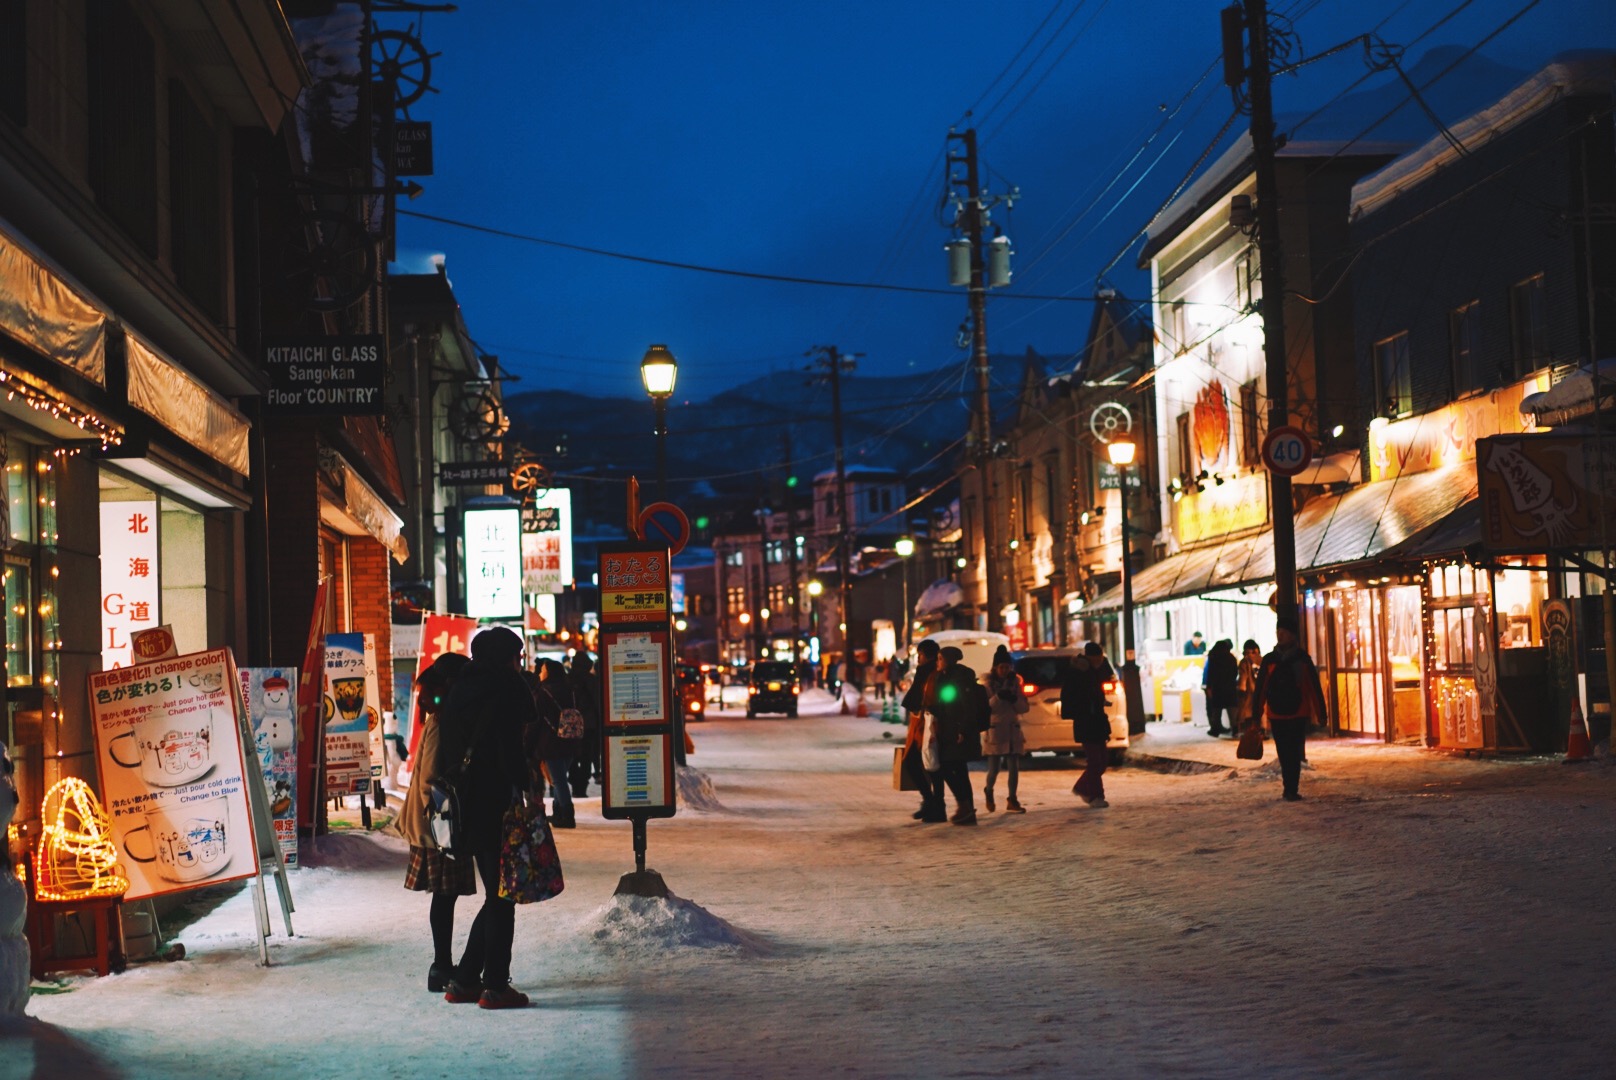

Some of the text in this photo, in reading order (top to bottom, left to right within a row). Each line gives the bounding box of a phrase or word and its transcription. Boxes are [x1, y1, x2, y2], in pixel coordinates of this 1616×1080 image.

[267, 346, 378, 363] KITAICHI GLASS
[289, 366, 355, 384] Sangokan
[268, 389, 303, 405] Floor
[1272, 440, 1305, 463] 40
[522, 509, 534, 520] INE
[606, 557, 661, 573] おたる
[526, 573, 559, 583] ALIAN
[606, 573, 662, 588] 散策バス
[614, 592, 665, 606] 北一硝子前
[621, 614, 648, 622] 中央バス
[154, 657, 192, 675] change
[195, 651, 225, 668] color!
[162, 699, 177, 709] Just
[178, 697, 194, 708] pour
[196, 693, 208, 702] hot
[168, 699, 225, 717] Change to Pink
[174, 786, 189, 797] Just
[190, 784, 206, 796] pour
[208, 779, 223, 789] cold
[180, 786, 239, 804] Change to Blue
